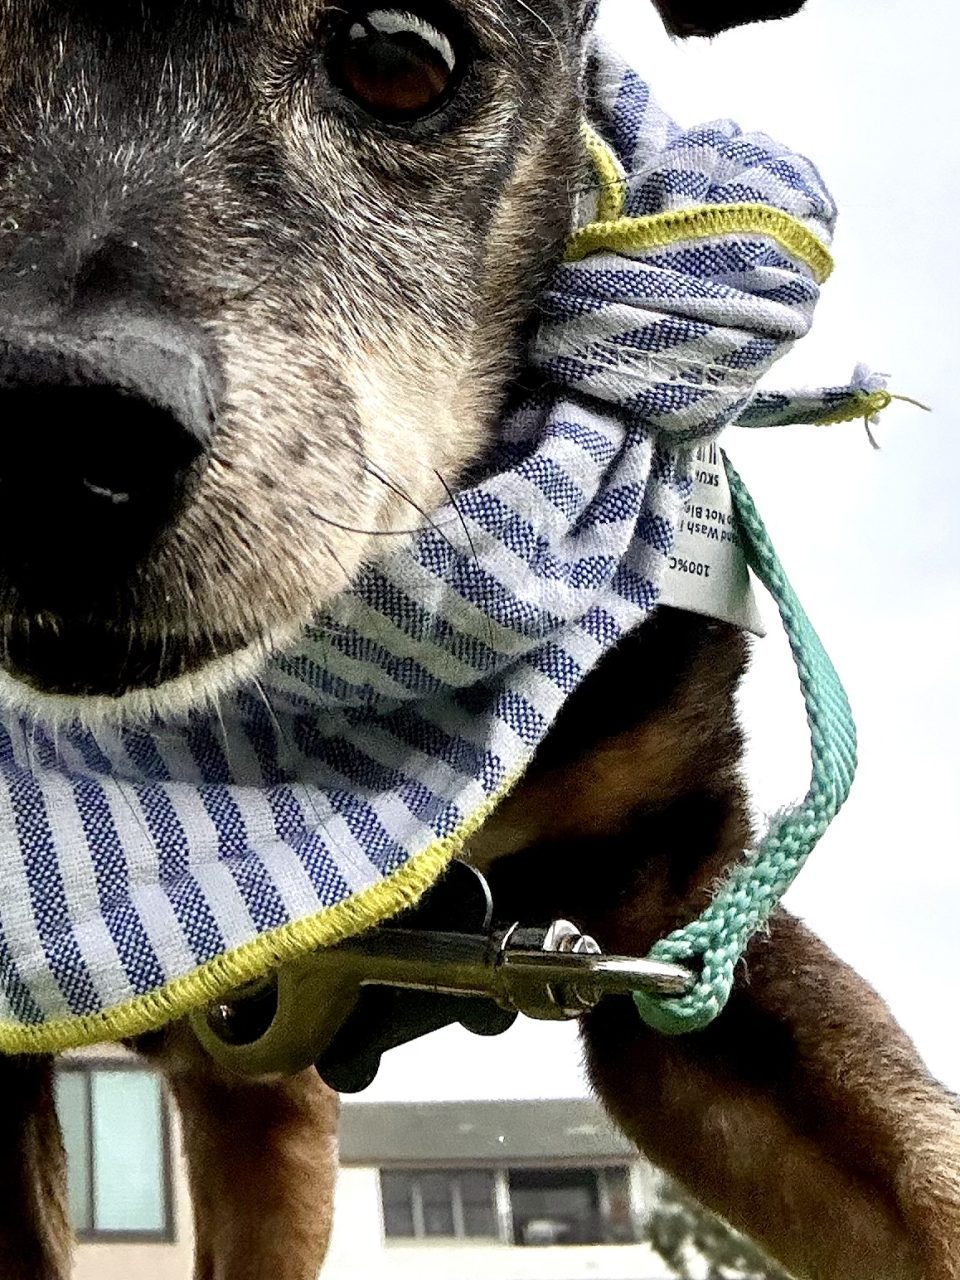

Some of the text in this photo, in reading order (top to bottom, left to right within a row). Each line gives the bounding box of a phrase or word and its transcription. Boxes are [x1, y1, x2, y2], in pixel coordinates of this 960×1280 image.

[705, 508, 725, 524] Not
[687, 521, 719, 539] Wash
[720, 530, 737, 544] and
[669, 557, 711, 577] 100%C
